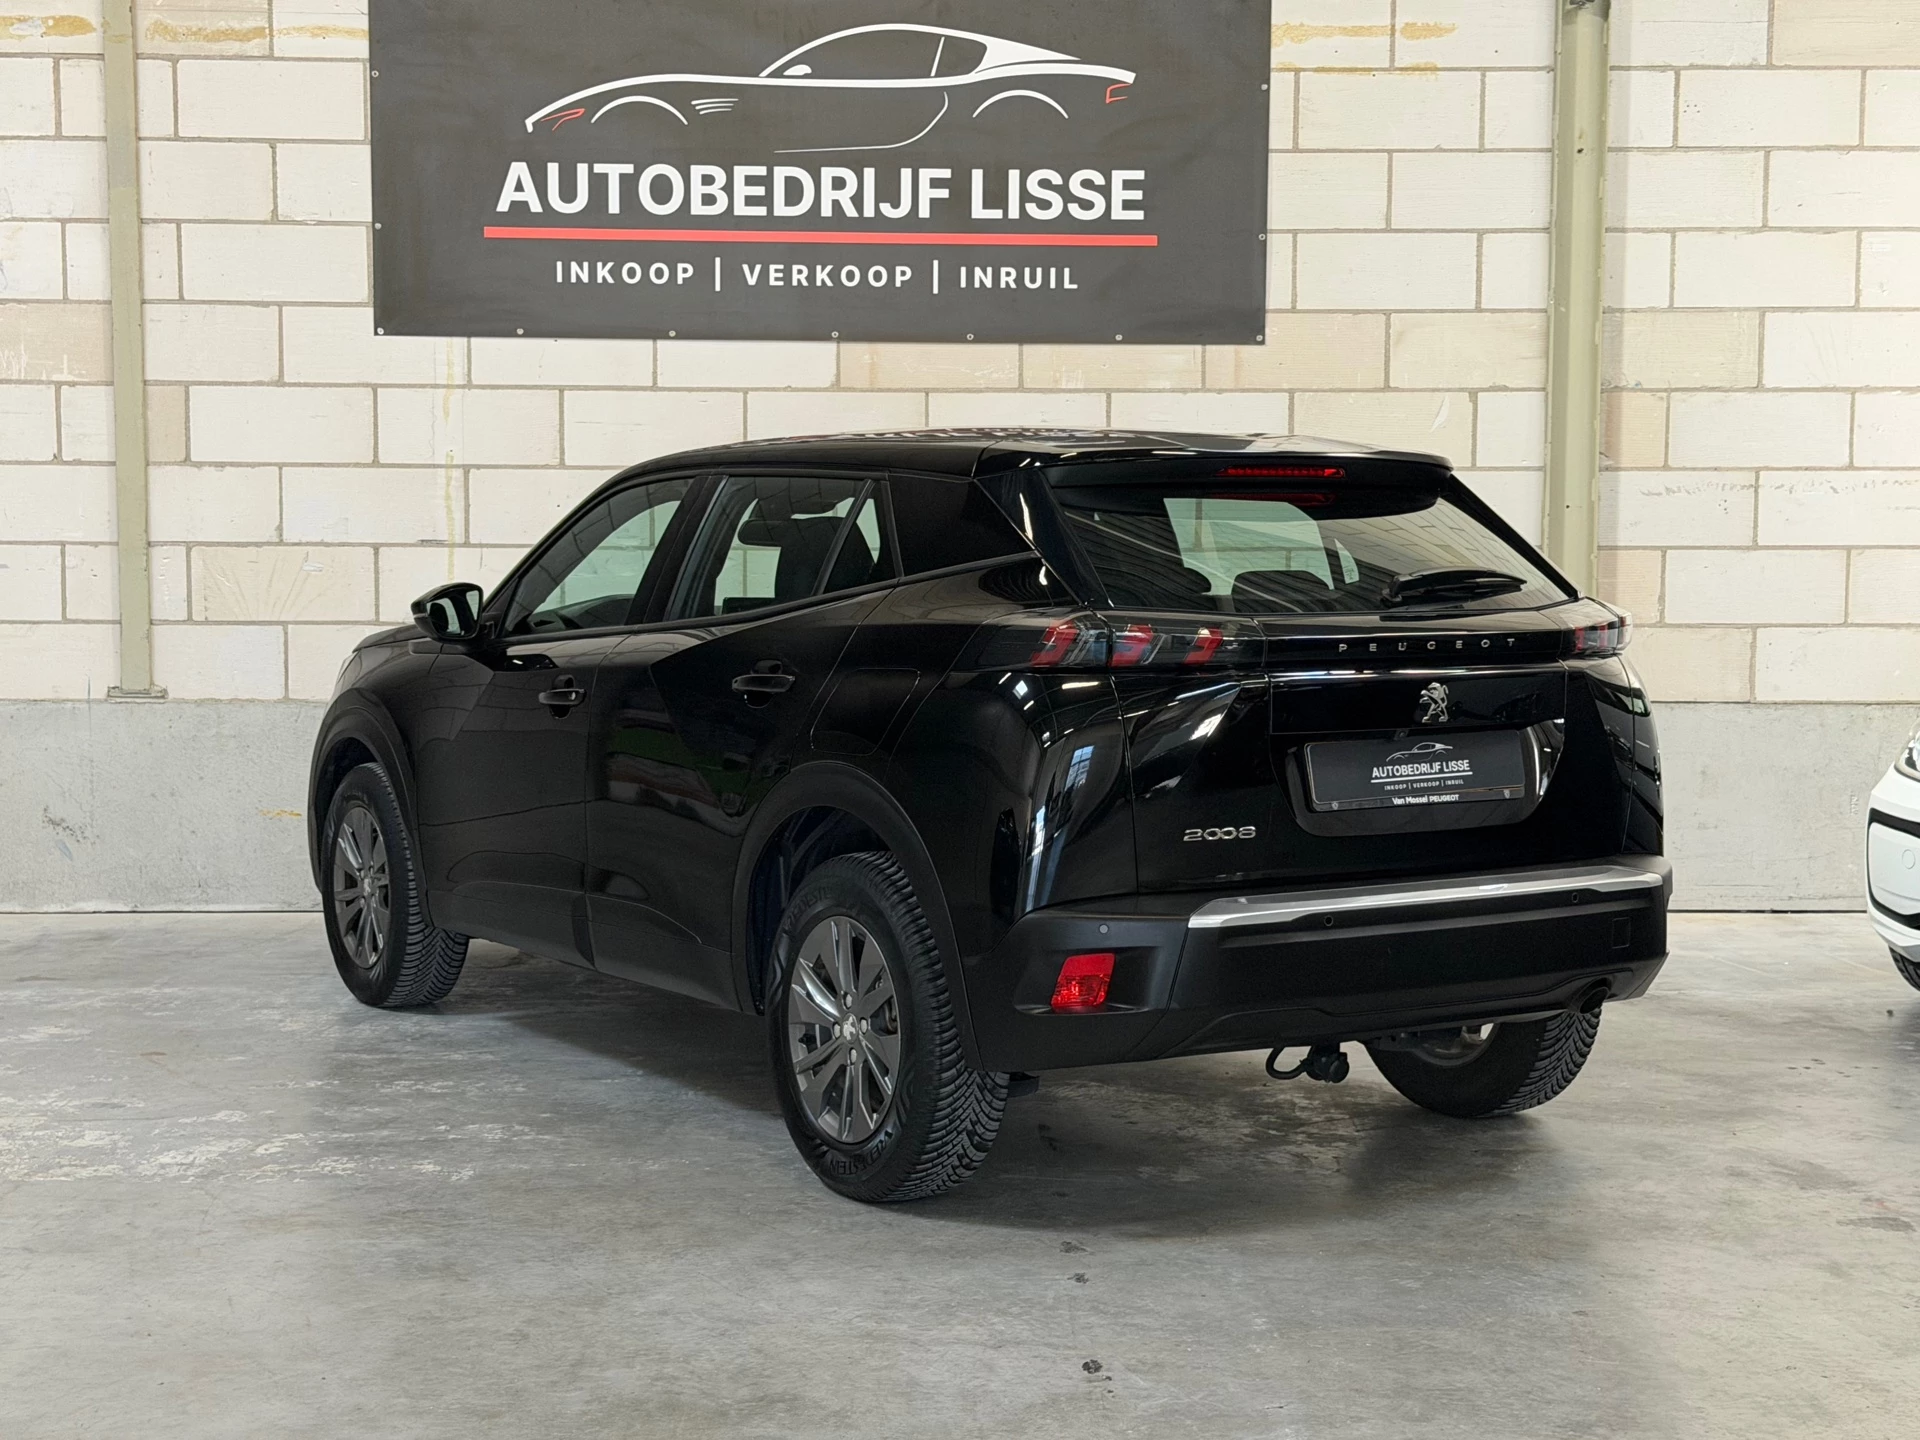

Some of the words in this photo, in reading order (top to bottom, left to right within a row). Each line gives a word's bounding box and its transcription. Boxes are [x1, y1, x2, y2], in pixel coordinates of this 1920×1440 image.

[496, 161, 951, 219] AUTOBEDRIJF
[971, 168, 1146, 221] LISSE
[555, 260, 695, 285] INKOOP
[741, 262, 913, 289] VERKOOP
[959, 266, 1079, 290] INRUIL
[1338, 637, 1516, 652] PEUGEOT
[1372, 762, 1441, 778] AUTOBEDRIJF
[1443, 760, 1470, 772] LISSE
[1384, 783, 1407, 791] INKOOP
[1413, 781, 1440, 789] VERKOOP
[1392, 797, 1405, 805] Van
[1406, 795, 1428, 804] Mossel
[1429, 794, 1460, 803] PEUGEOT
[1183, 826, 1256, 841] 2008
